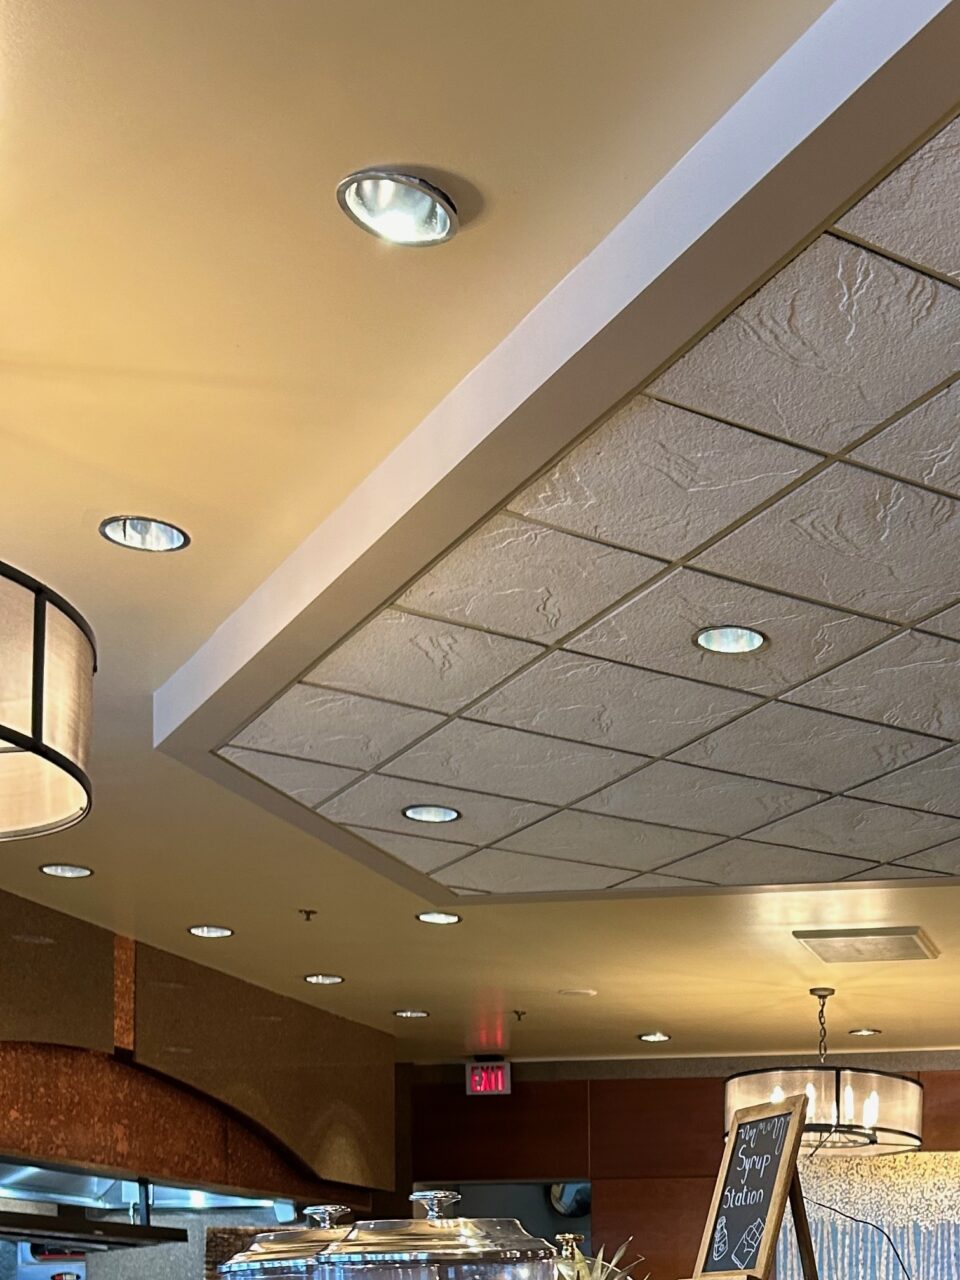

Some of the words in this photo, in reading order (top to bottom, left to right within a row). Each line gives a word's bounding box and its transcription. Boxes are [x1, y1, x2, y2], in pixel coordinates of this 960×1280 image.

[471, 1066, 505, 1093] EXIT
[736, 1144, 771, 1185] Syrup
[722, 1186, 765, 1209] Station
